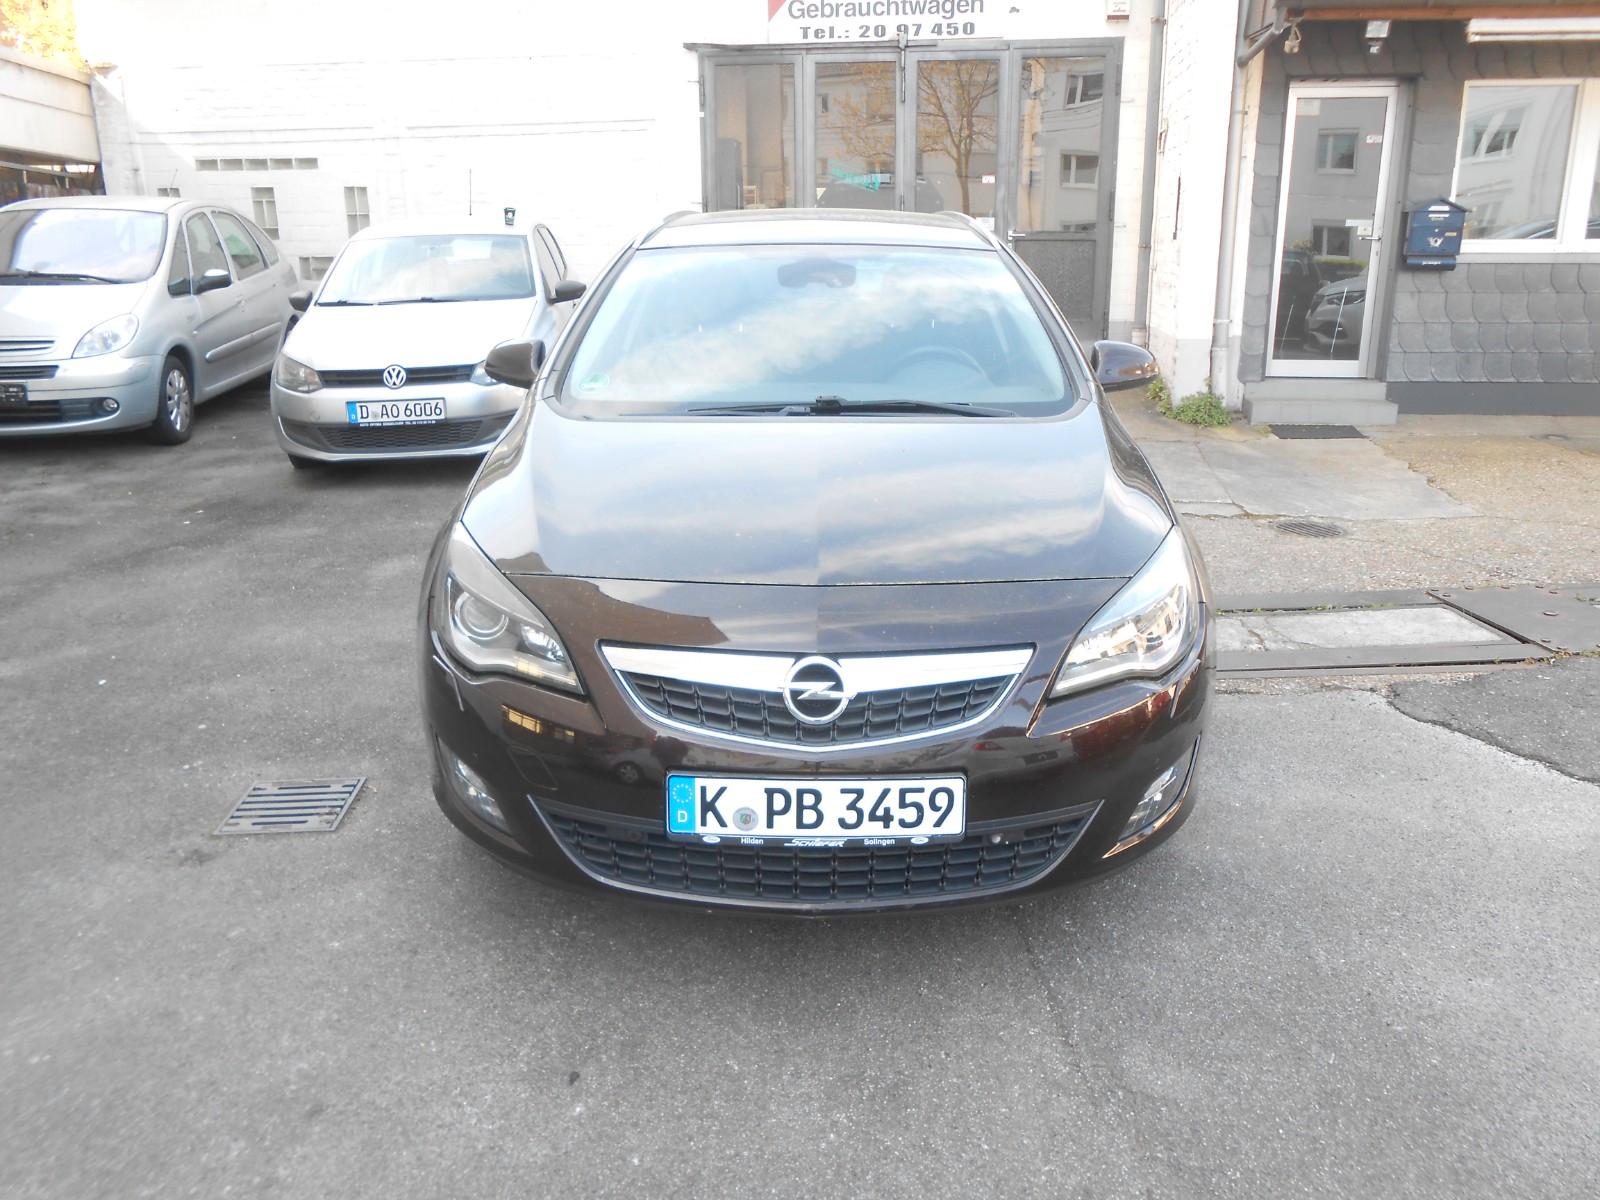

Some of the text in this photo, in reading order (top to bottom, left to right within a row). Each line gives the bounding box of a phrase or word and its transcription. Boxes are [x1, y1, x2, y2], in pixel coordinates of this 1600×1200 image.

[787, 0, 984, 19] Gebrauchtwagen
[800, 22, 975, 39] Tel.: 20 97 450
[359, 404, 369, 419] D
[404, 402, 443, 418] 6006
[677, 785, 955, 830] D K PB 3459
[741, 837, 764, 845] Hilden
[863, 838, 896, 846] Solingen
